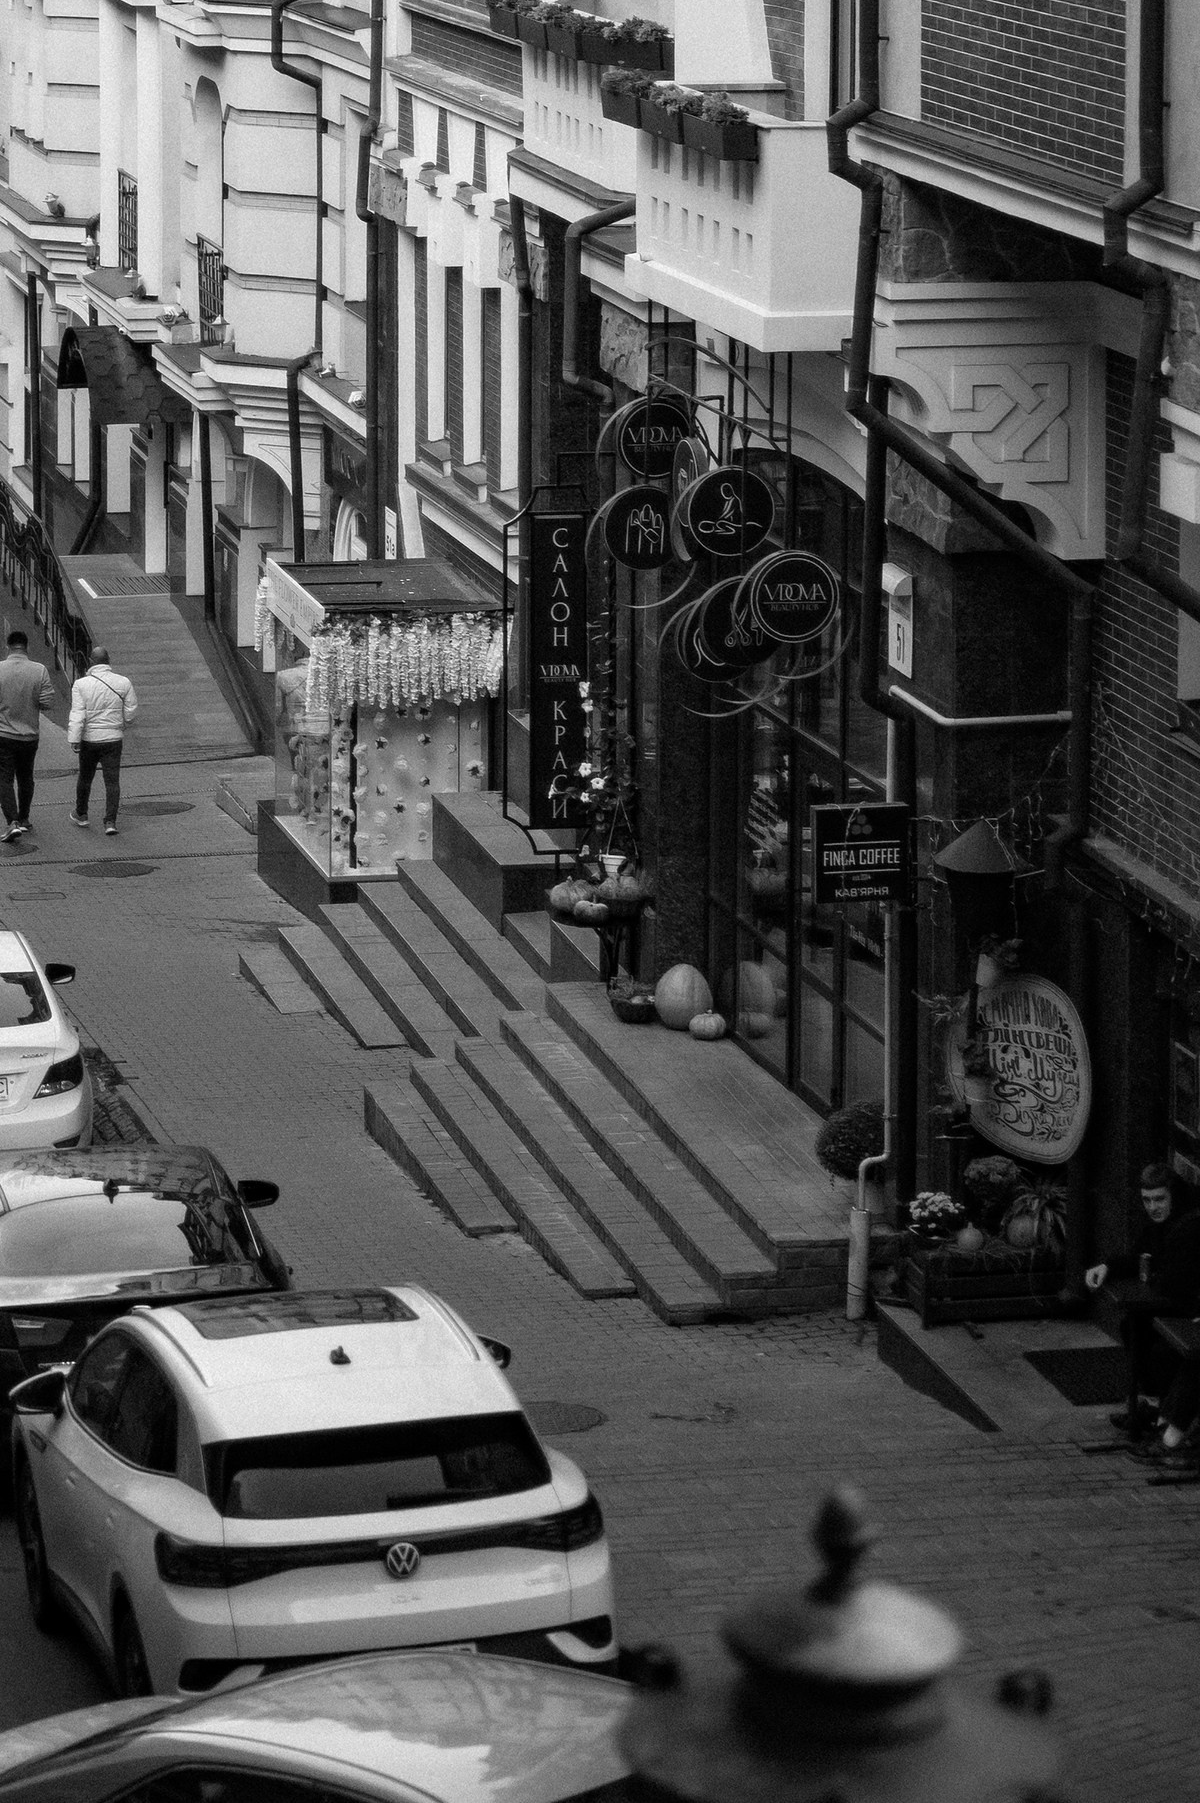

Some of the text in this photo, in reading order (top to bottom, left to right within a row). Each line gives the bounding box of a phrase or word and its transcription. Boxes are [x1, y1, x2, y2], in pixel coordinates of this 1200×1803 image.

[550, 527, 571, 647] САЛОН
[896, 622, 905, 665] 51
[552, 700, 568, 819] КРАСИ
[822, 847, 901, 867] FINCA COFFEE
[834, 886, 889, 898] КАВ'ЯРНЯ
